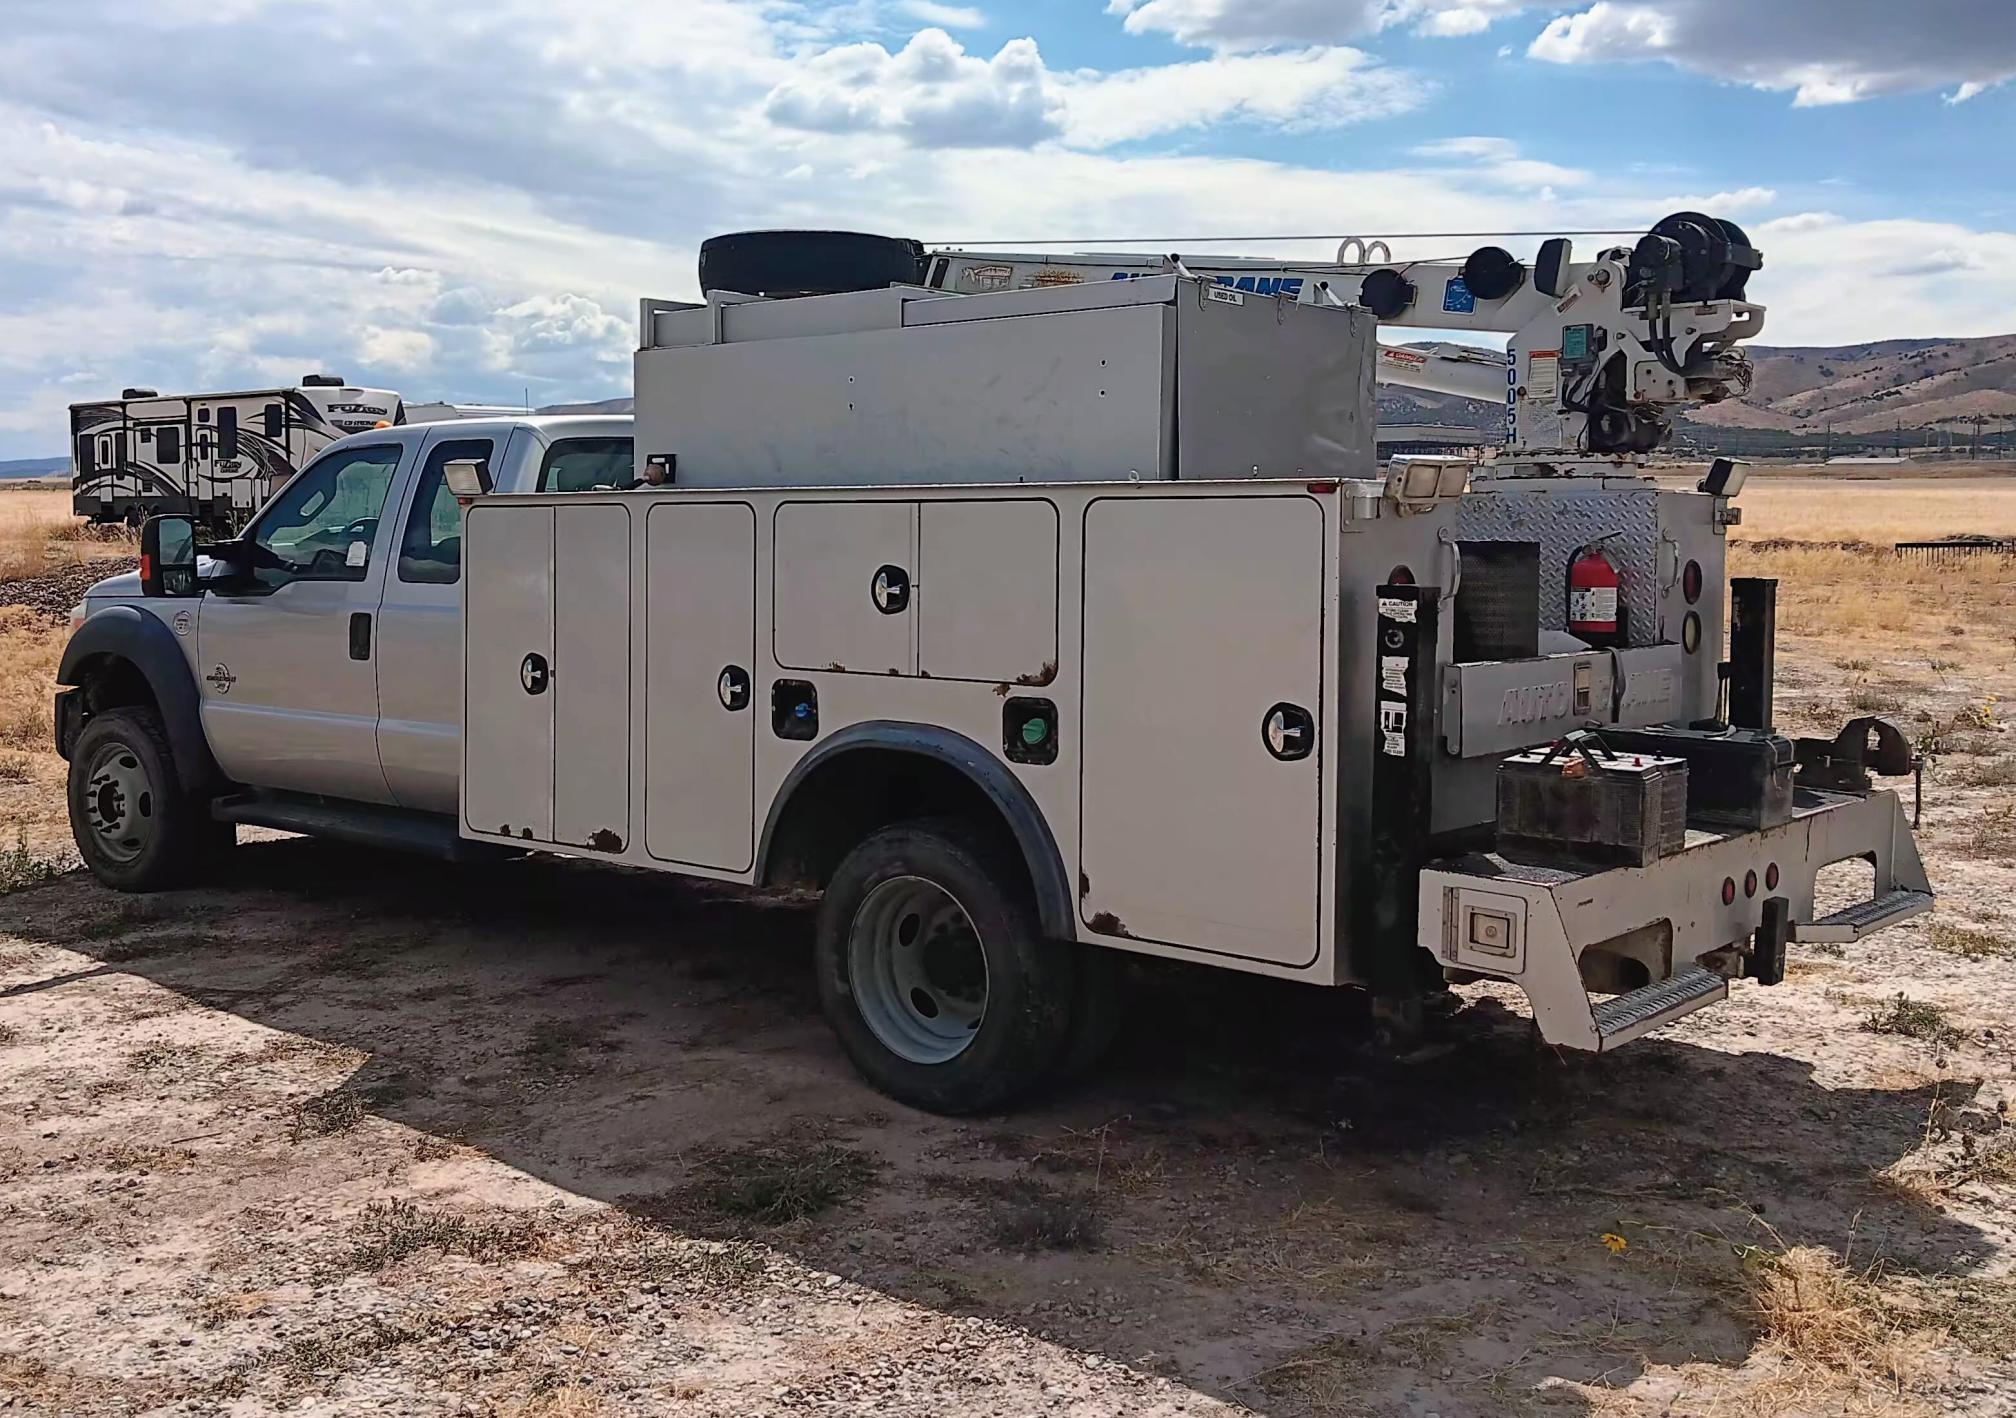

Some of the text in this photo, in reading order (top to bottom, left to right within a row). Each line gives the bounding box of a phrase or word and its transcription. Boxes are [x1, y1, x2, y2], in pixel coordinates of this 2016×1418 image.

[1213, 291, 1238, 302] USED OIL
[1506, 348, 1517, 444] 5005H
[1497, 682, 1569, 726] AUTO
